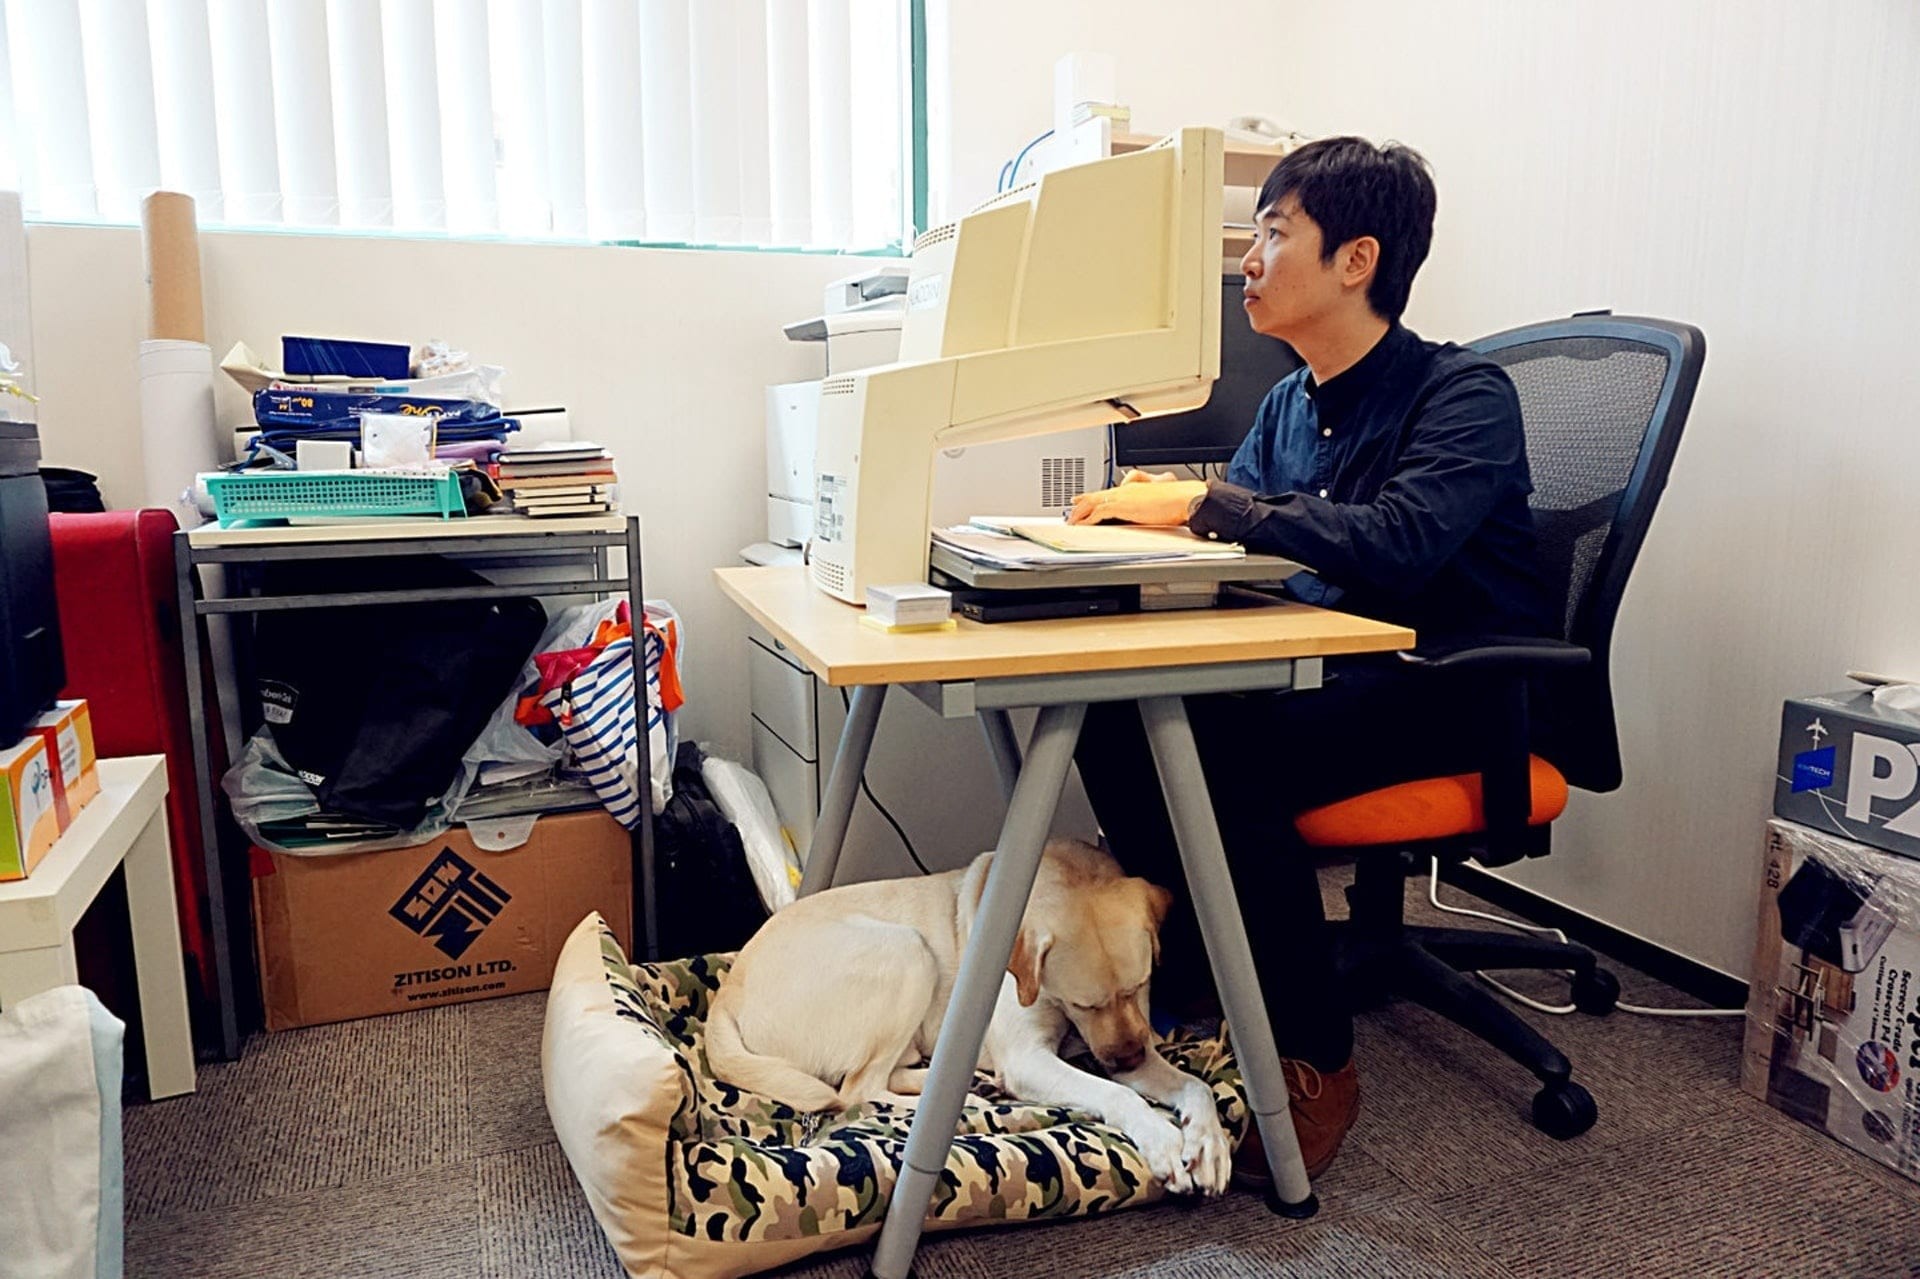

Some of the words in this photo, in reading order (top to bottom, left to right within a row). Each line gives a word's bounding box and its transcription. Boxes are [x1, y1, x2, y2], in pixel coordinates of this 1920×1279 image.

[1766, 859, 1781, 889] 428
[394, 965, 471, 987] ZITISON
[476, 960, 517, 976] LTD.
[1876, 955, 1887, 986] Cutting
[408, 982, 506, 1001] www.zitison.com
[1883, 969, 1898, 1023] Cross-cut
[1896, 969, 1912, 1015] Secrecy
